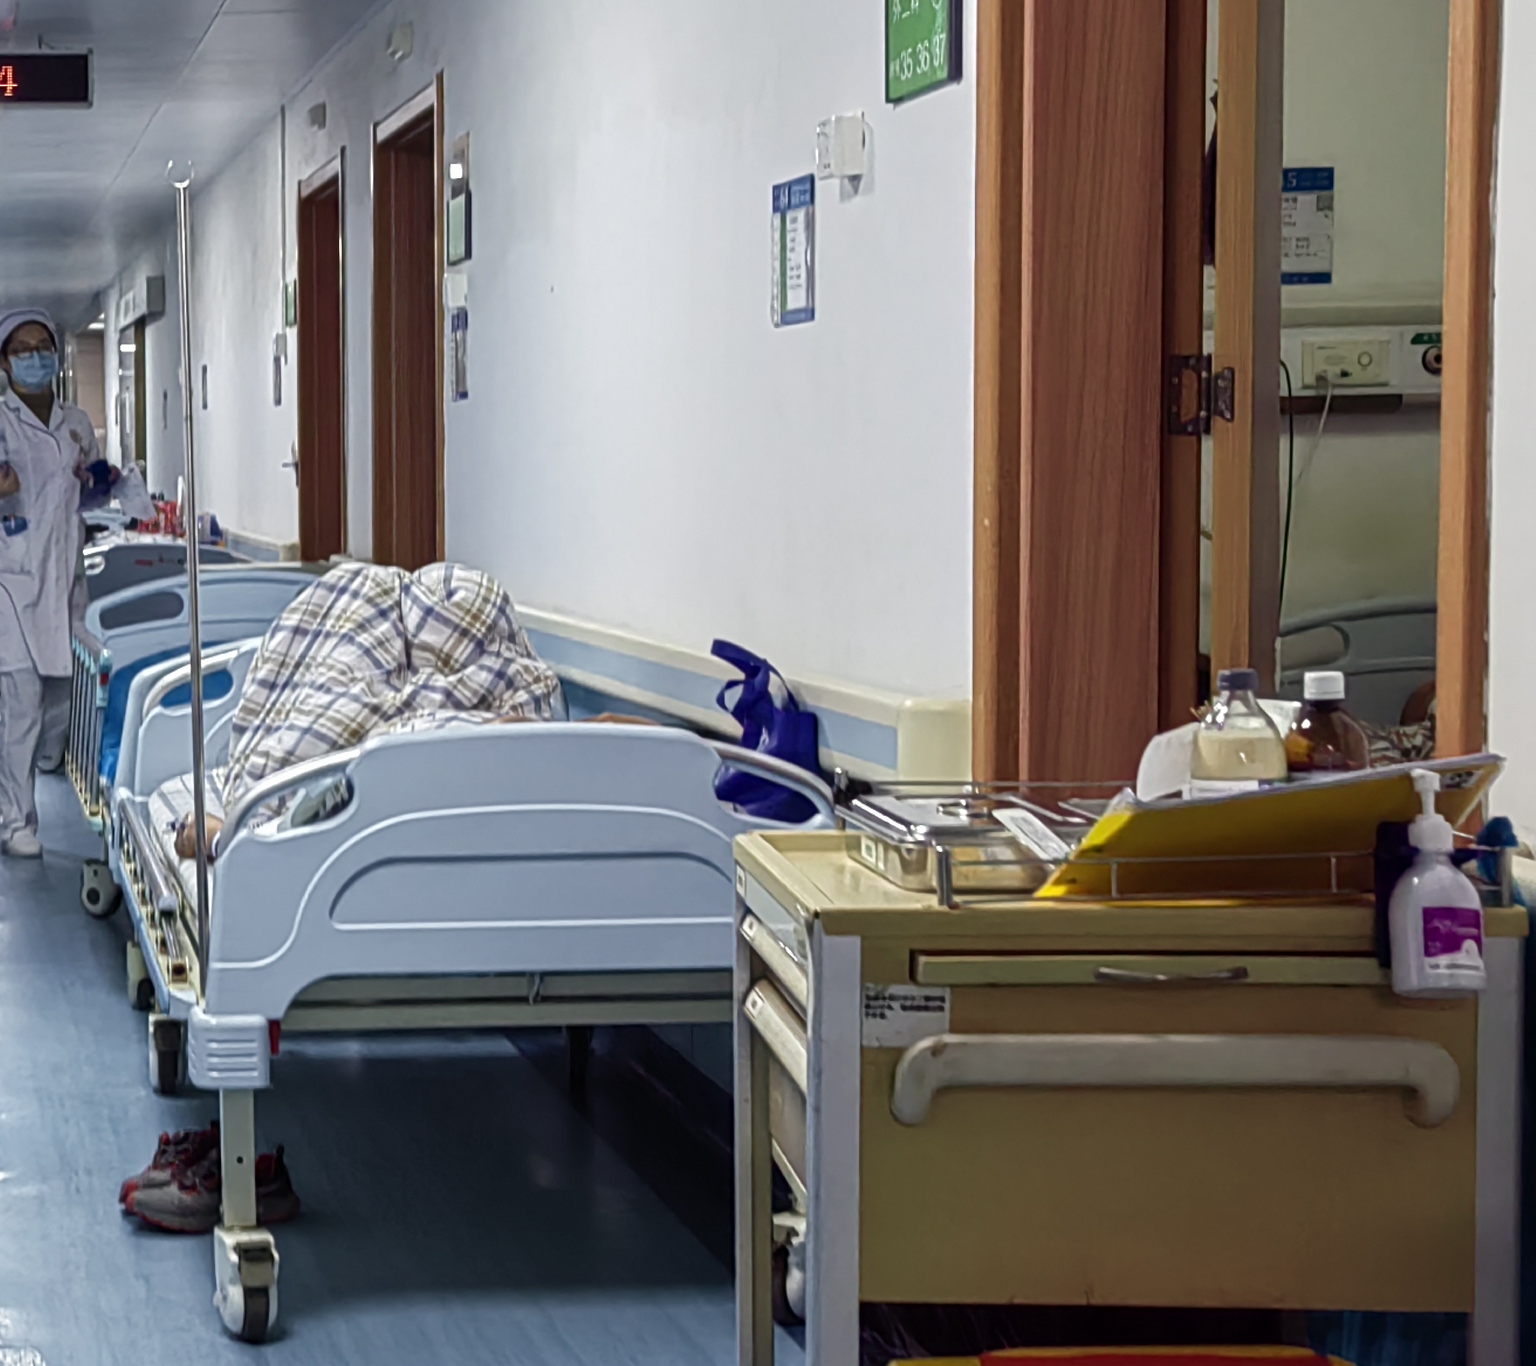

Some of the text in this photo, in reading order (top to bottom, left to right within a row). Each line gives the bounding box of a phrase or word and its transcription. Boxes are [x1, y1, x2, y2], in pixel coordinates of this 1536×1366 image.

[900, 47, 913, 80] 35
[916, 39, 930, 74] 36
[933, 33, 946, 67] 37
